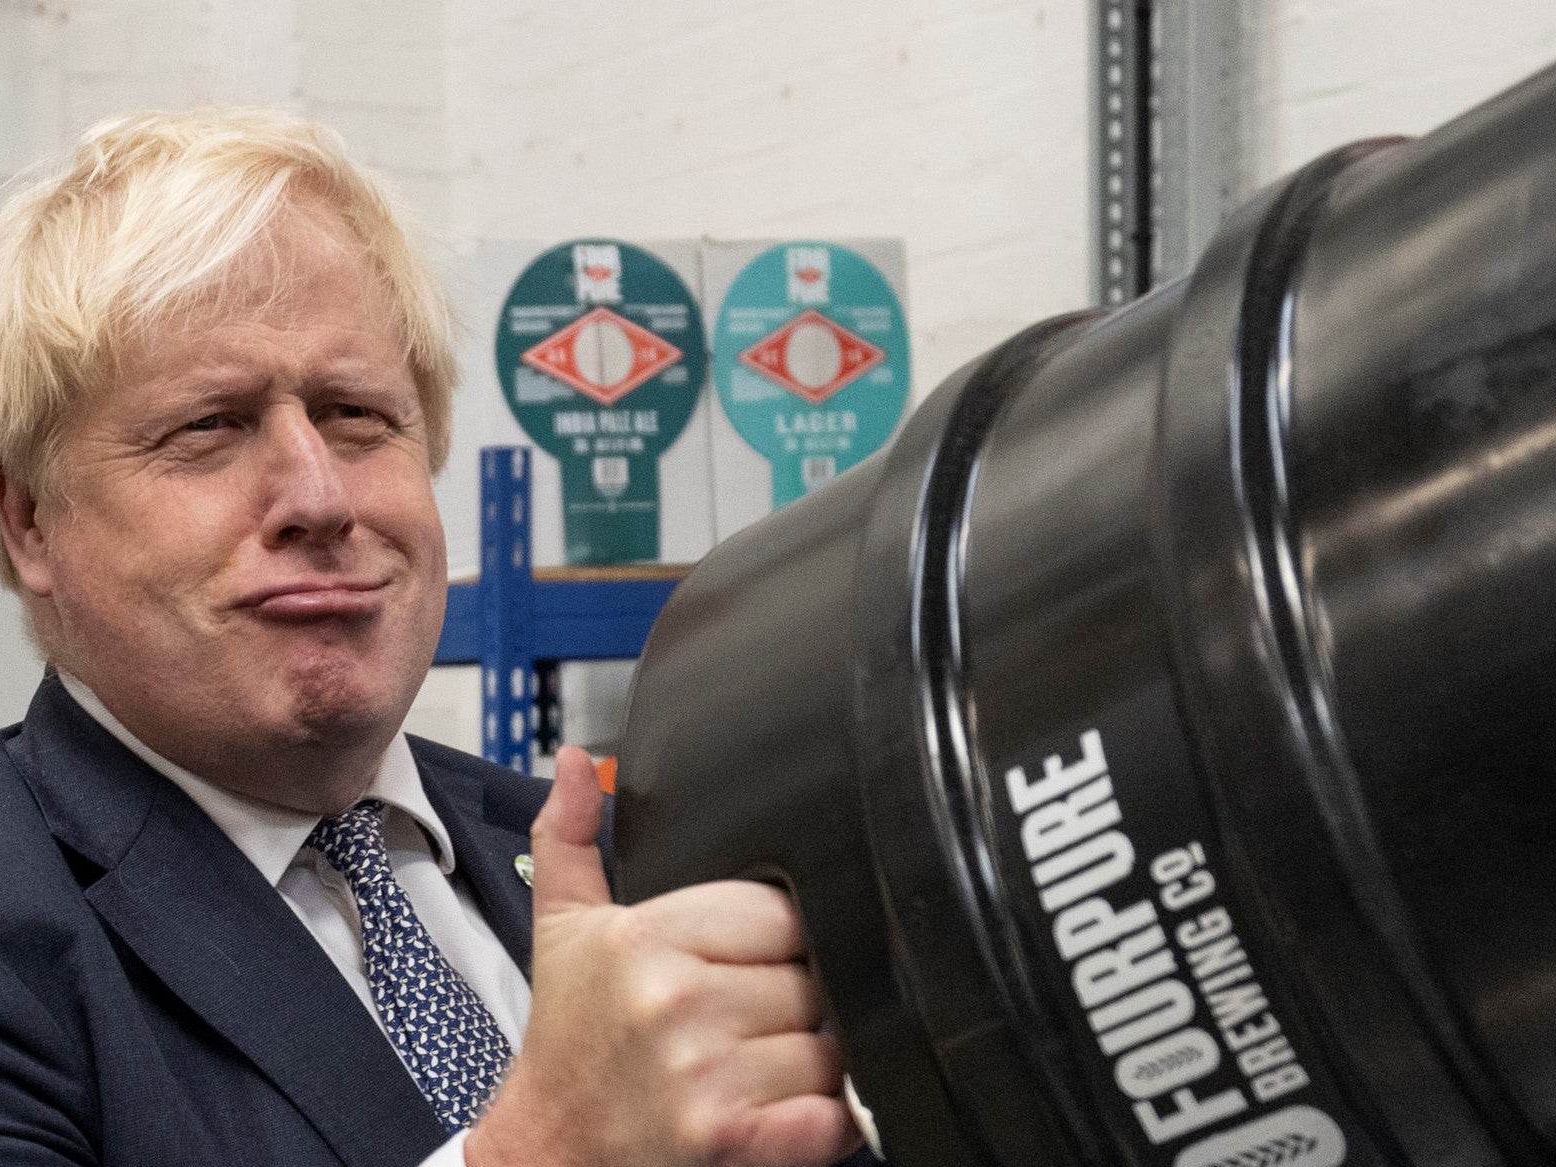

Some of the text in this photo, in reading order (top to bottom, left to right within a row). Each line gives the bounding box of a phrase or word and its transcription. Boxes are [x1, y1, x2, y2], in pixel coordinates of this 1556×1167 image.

[775, 411, 857, 433] LAGER
[1005, 727, 1248, 1145] FOURPURE
[1176, 905, 1311, 1102] BREWING
